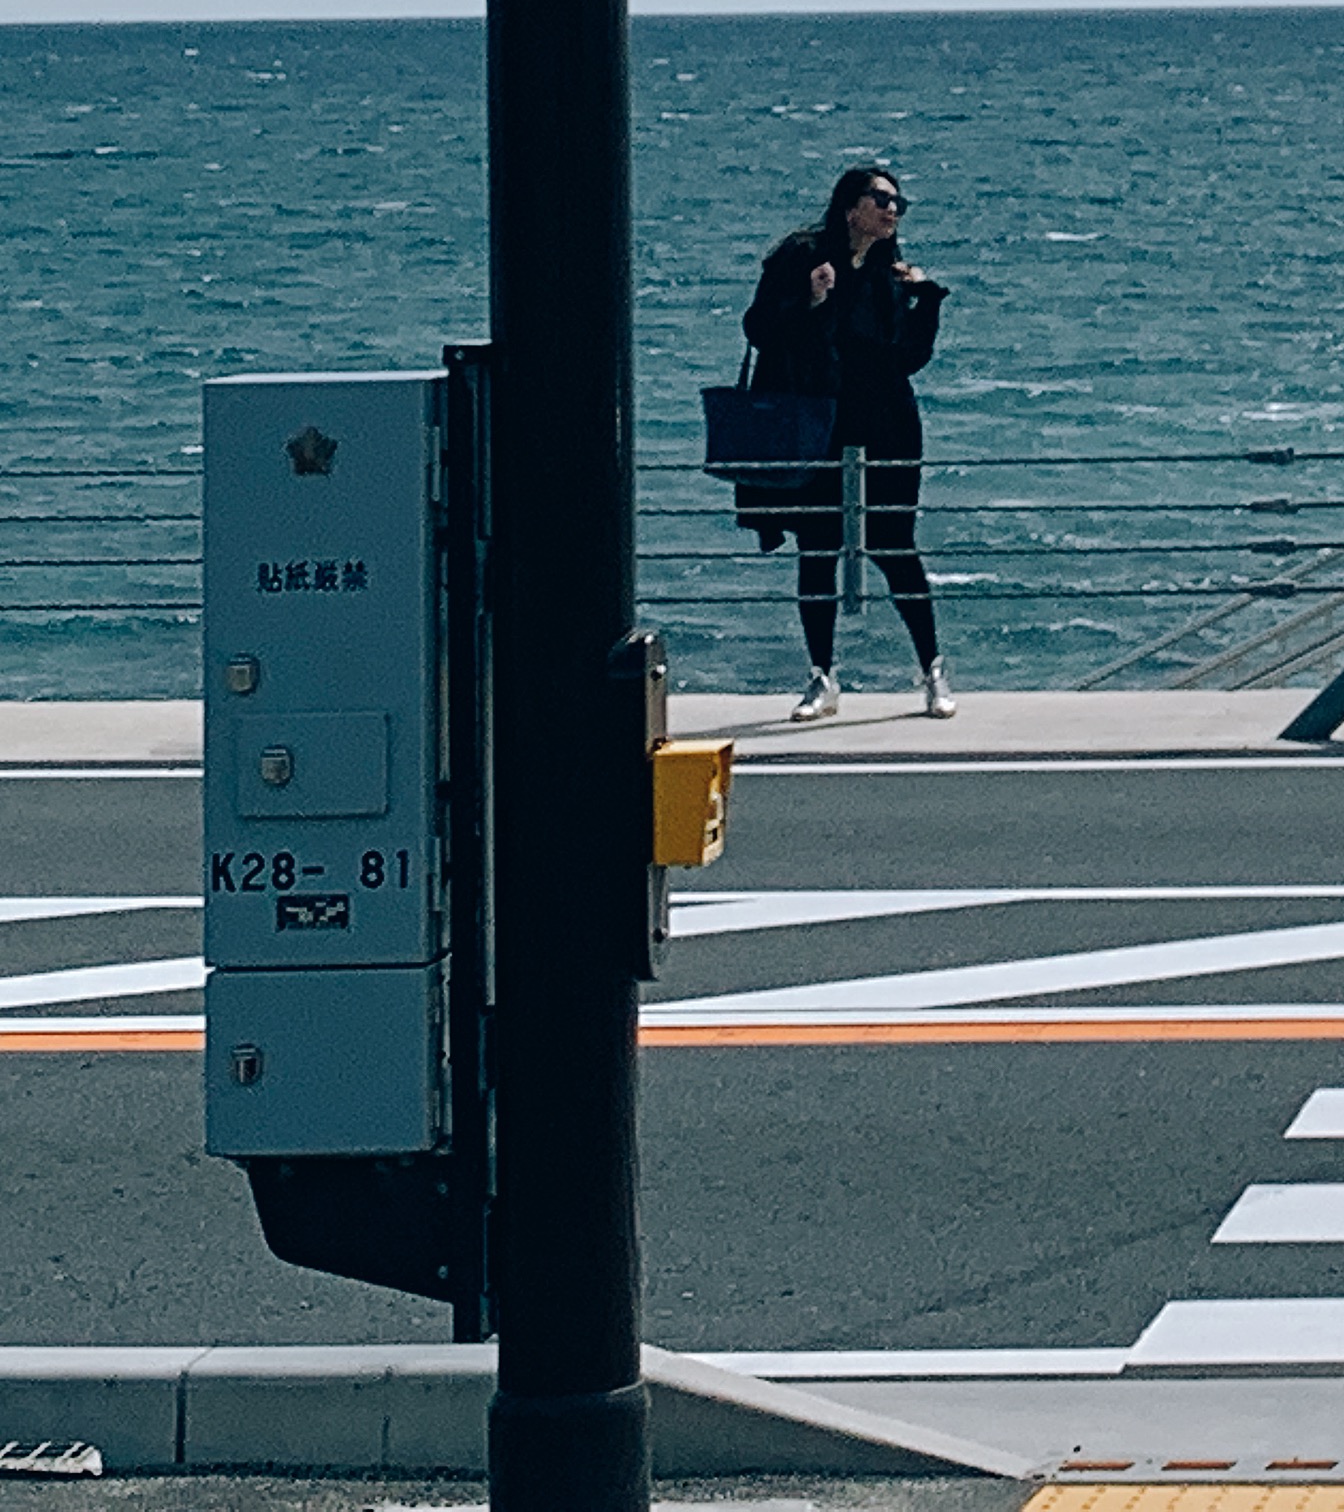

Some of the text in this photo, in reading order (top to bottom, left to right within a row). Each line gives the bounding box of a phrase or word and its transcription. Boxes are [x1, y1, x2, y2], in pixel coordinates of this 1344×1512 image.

[256, 559, 369, 594] 貼紙厳禁
[211, 849, 409, 893] K28- 81
